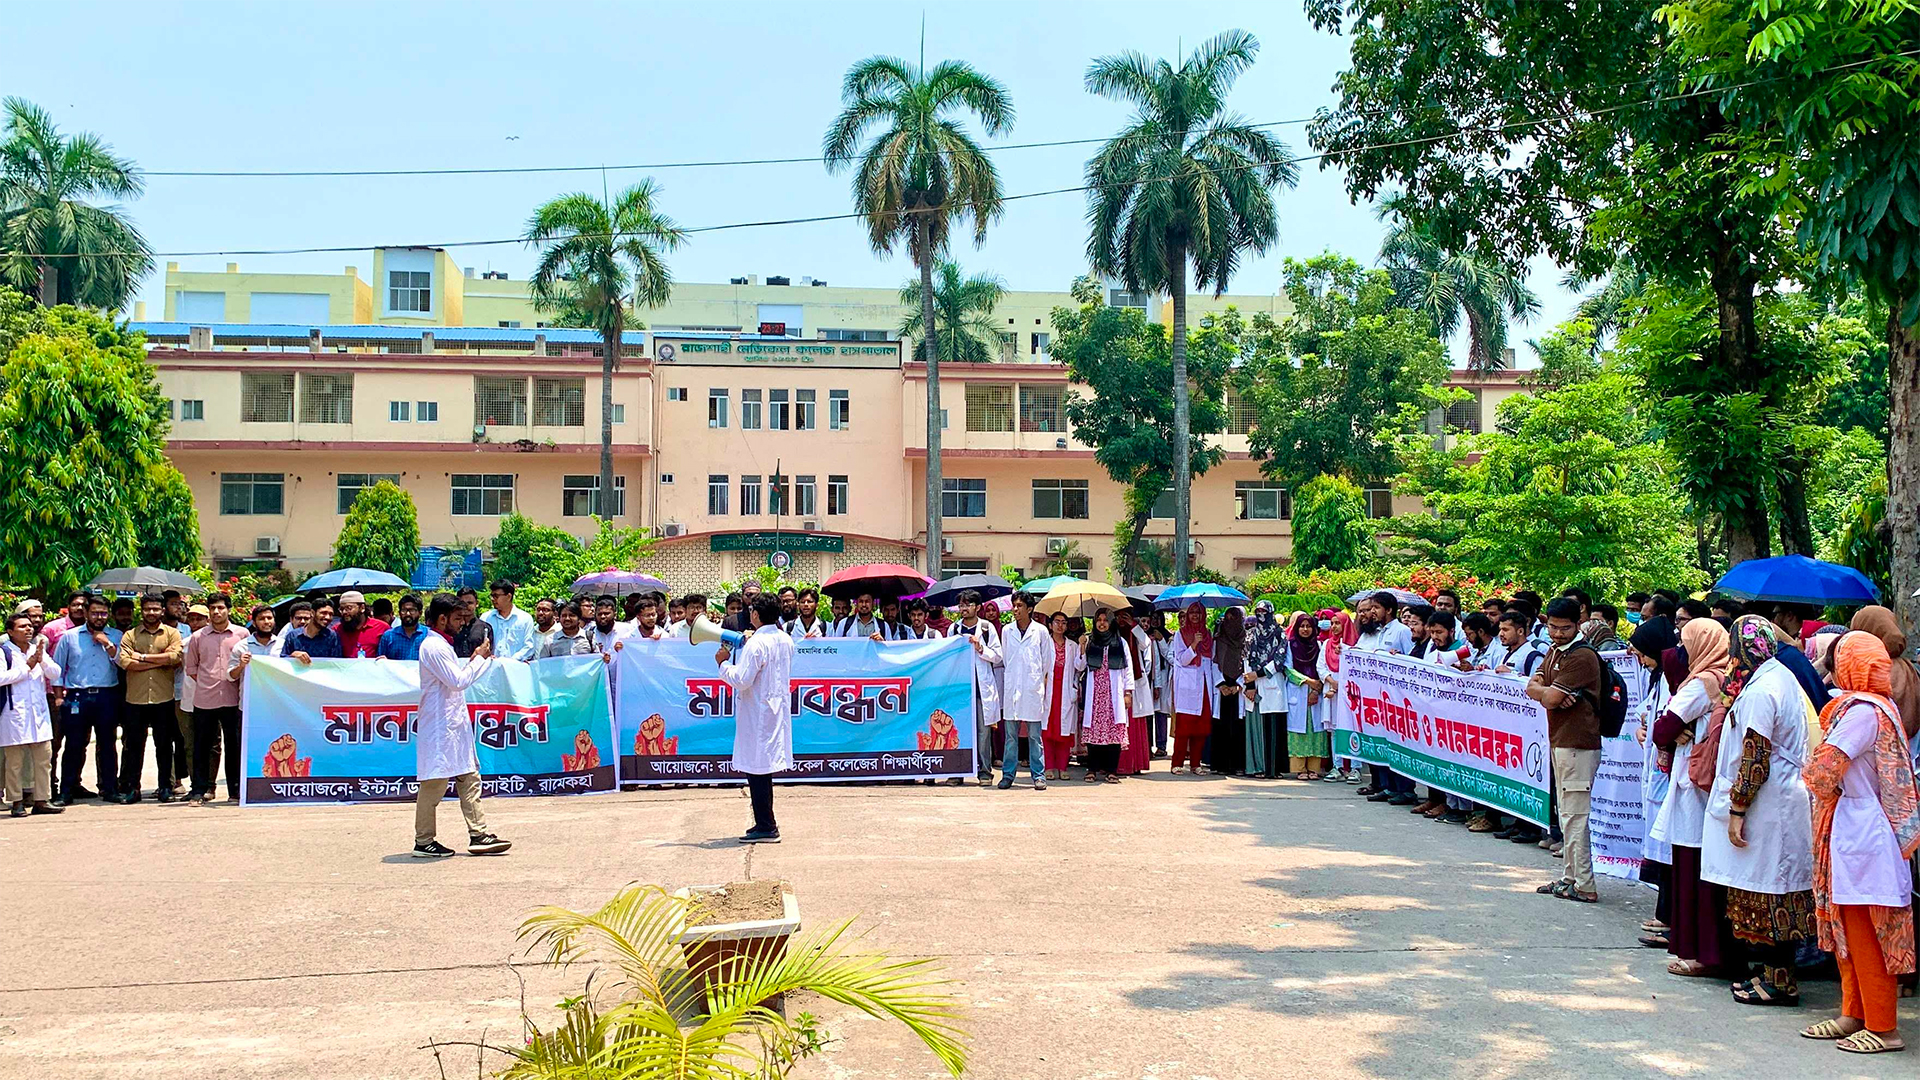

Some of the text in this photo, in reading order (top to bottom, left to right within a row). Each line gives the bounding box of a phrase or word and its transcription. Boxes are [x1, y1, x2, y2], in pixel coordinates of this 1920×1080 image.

[761, 324, 784, 334] 23:27
[681, 341, 897, 356] রাজশাহী মেডিকেল কলেজ হাসপাতাল
[797, 645, 838, 654] রহমানির রহিম
[685, 676, 912, 725] মাবন্ধন
[1458, 690, 1478, 705] প্রতিবাদে
[1484, 697, 1495, 708] দফা
[1521, 702, 1538, 718] দাবিতে
[321, 703, 551, 749] মানন্ধন
[1422, 714, 1434, 748] ও
[1434, 716, 1524, 770] মানববন্ধন
[650, 760, 714, 774] আয়োজনে:
[827, 757, 878, 771] কলেজের
[881, 752, 944, 774] শিক্ষার্থীবৃন্দ
[270, 781, 354, 797] আয়োজনে:
[358, 777, 404, 796] ইন্টার্ন
[537, 773, 594, 792] রামেকহা
[1461, 768, 1476, 792] ইন্টার্ন
